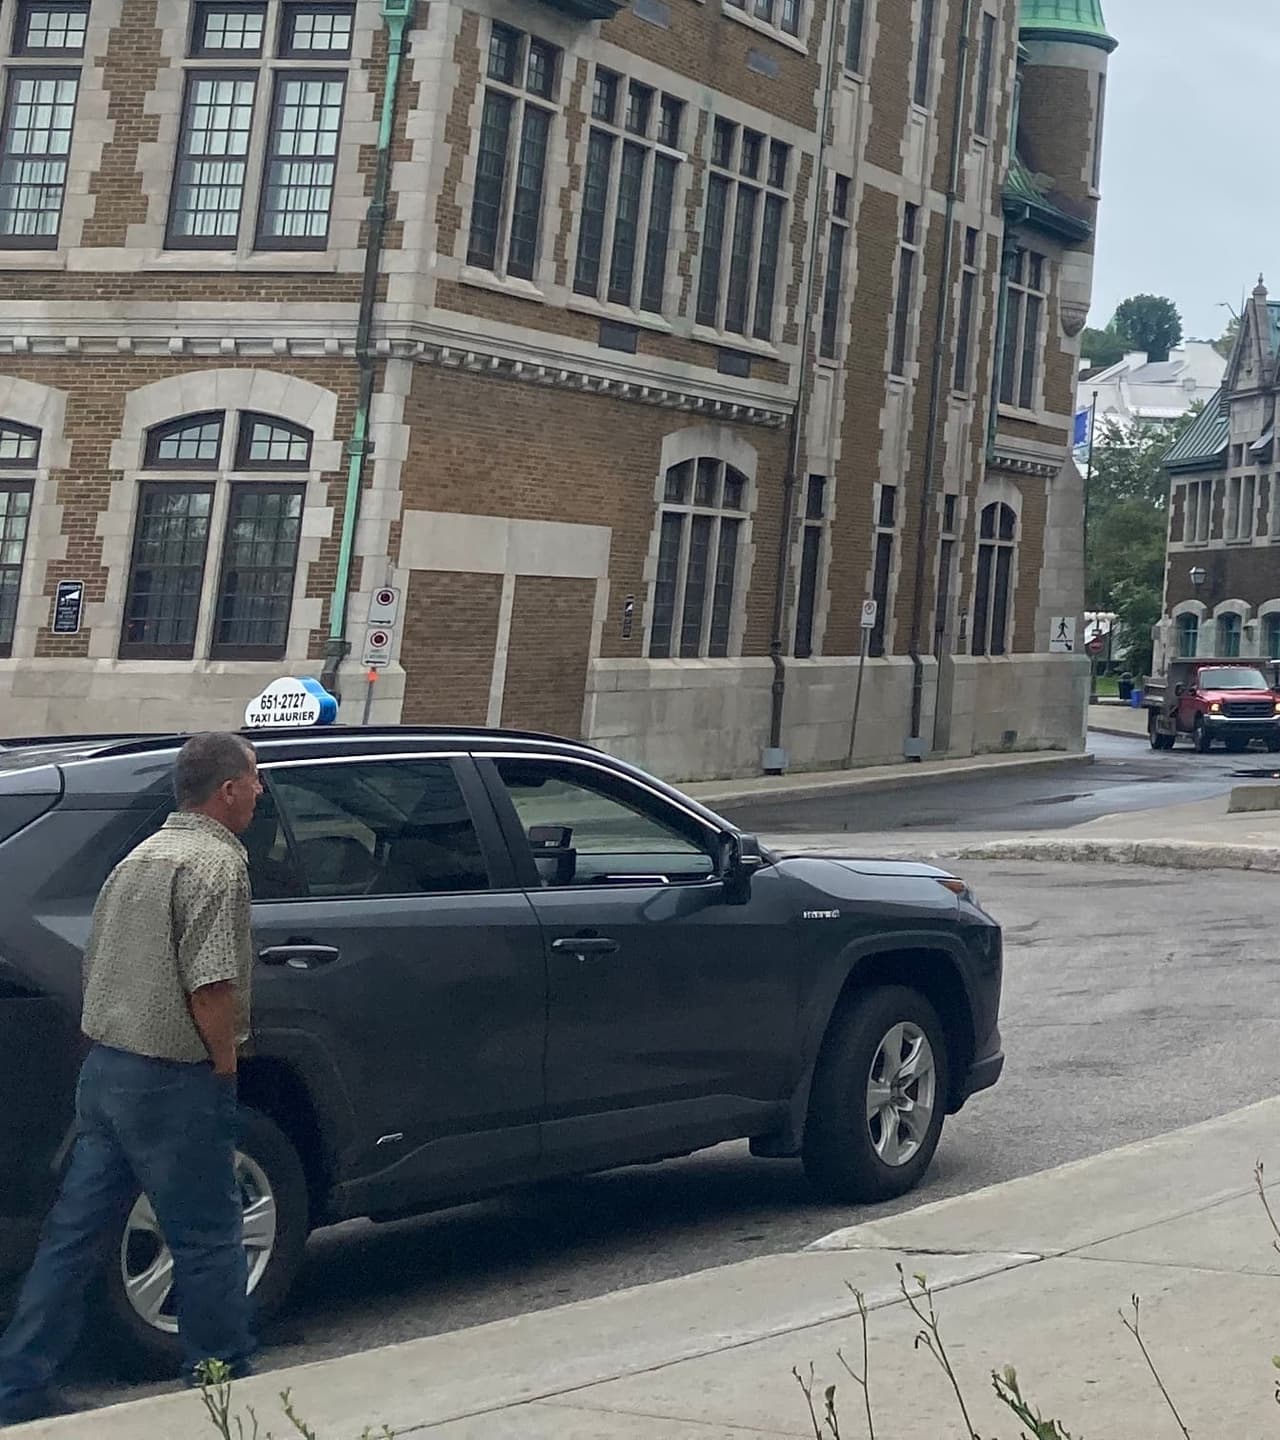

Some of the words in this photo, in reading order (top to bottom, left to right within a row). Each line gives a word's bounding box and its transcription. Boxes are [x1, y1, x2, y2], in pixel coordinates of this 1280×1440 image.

[260, 693, 306, 710] 651-2727
[250, 713, 271, 723] TAXI
[273, 711, 315, 722] LAURIER
